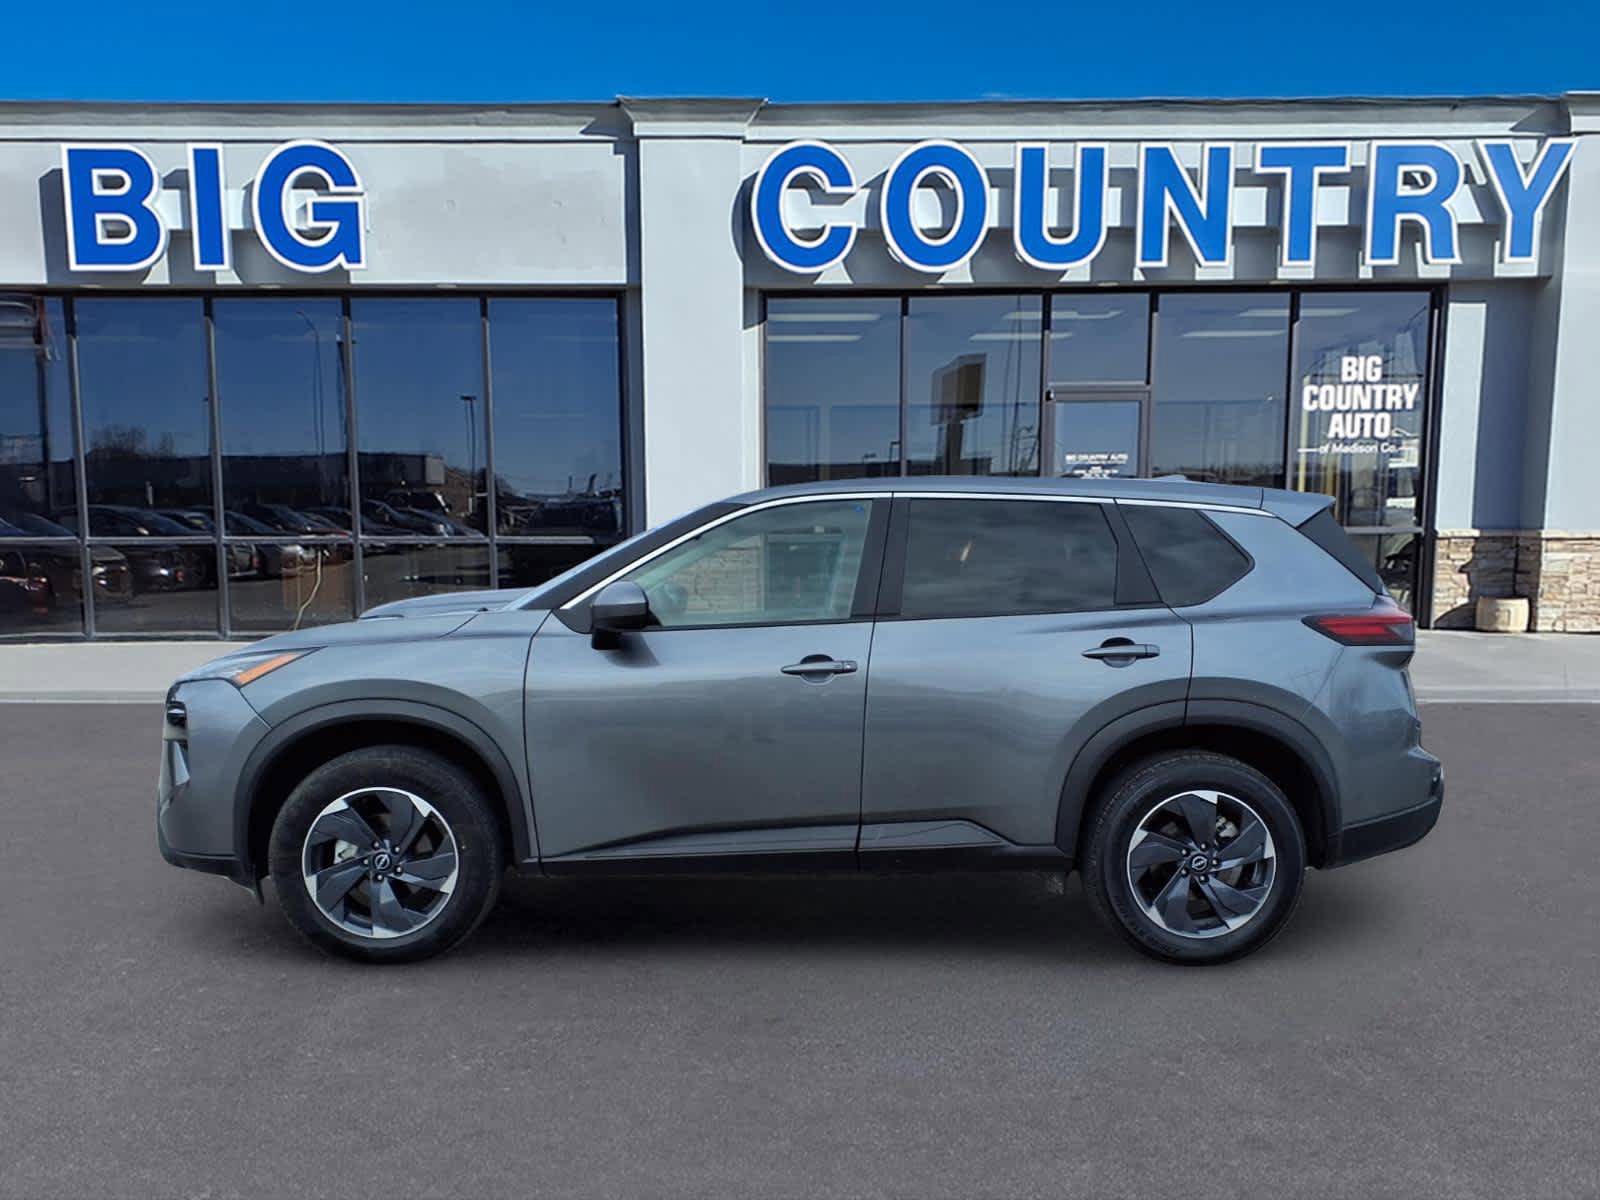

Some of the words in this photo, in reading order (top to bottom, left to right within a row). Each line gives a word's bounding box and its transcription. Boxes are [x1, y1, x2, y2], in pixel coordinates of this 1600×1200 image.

[61, 139, 367, 272] BIG
[750, 139, 1575, 273] COUNTRY
[1341, 355, 1383, 382] BIG
[1302, 383, 1419, 411] COUNTRY
[1327, 412, 1392, 439] AUTO
[1331, 442, 1378, 454] Madison
